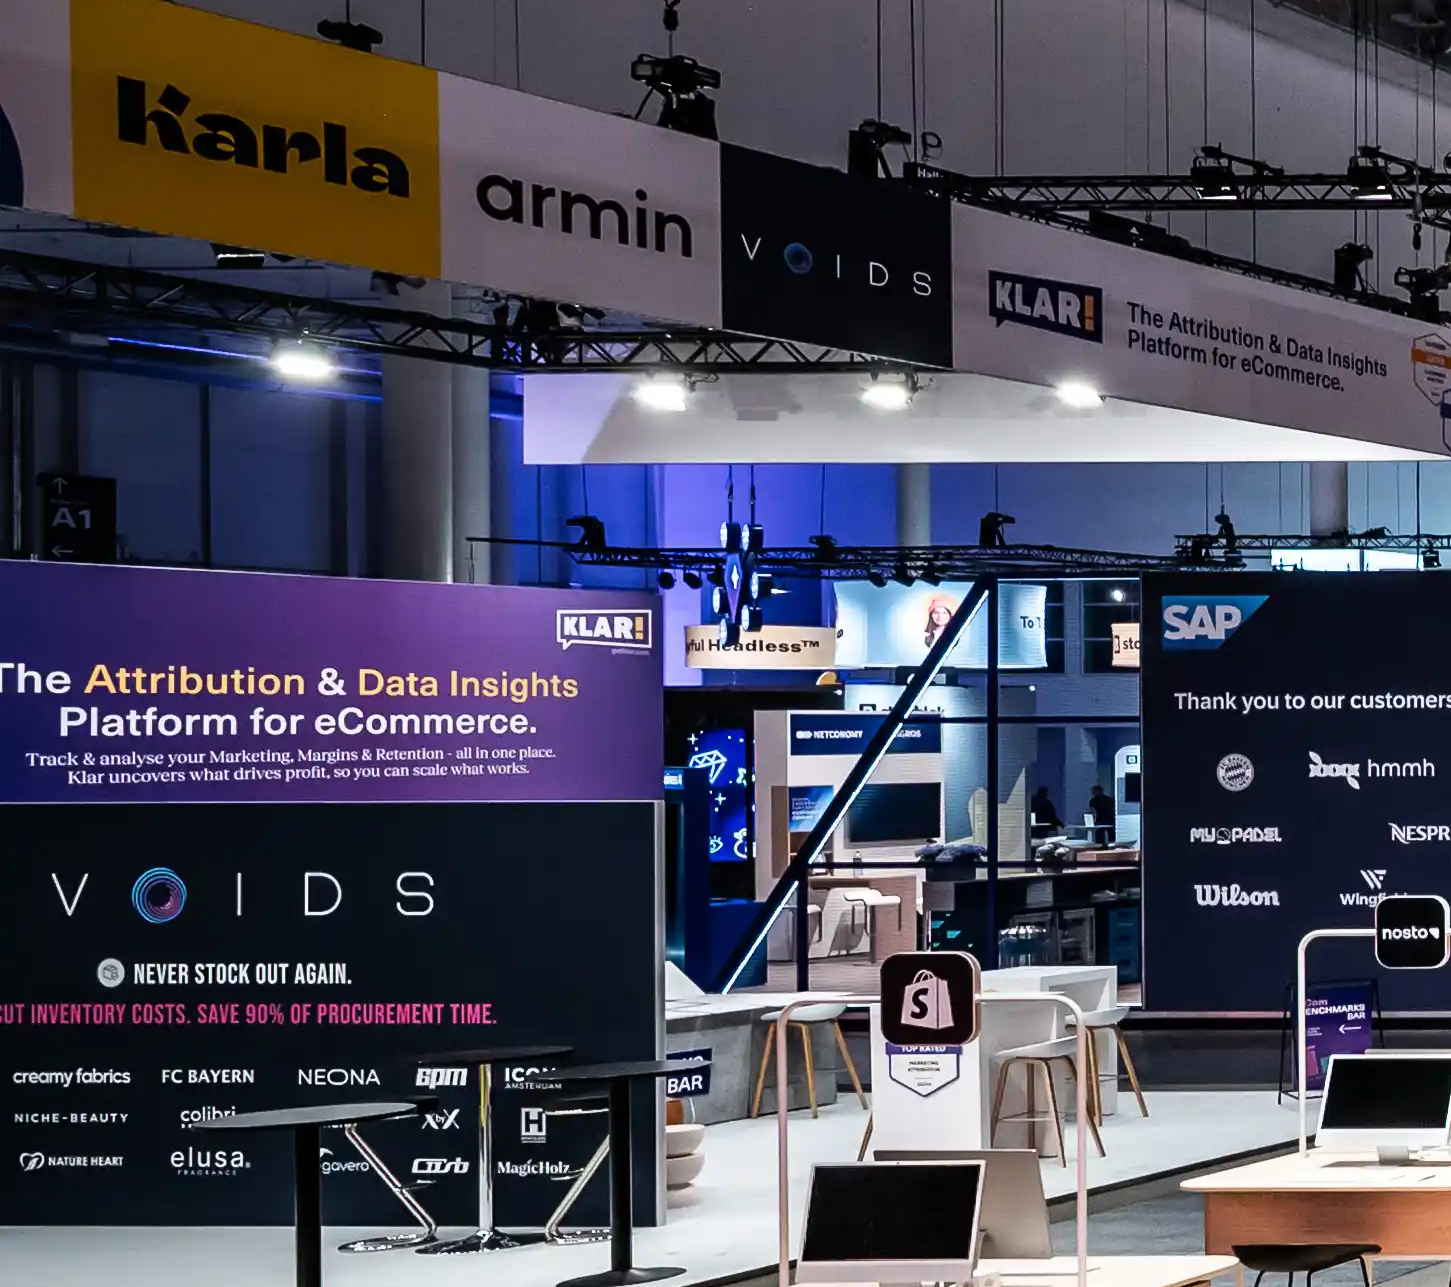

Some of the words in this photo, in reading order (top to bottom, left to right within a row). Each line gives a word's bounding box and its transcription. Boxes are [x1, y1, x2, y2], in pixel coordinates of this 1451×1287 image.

[116, 74, 410, 199] Karla
[477, 173, 694, 258] armin
[995, 279, 1094, 331] KLAR!
[1127, 301, 1164, 329] The
[1168, 311, 1265, 351] Attribution
[1268, 328, 1282, 352] &
[1286, 337, 1324, 363] Data
[1328, 346, 1388, 380] Insights
[1127, 333, 1208, 368] Platform
[1212, 343, 1236, 369] for
[1241, 352, 1345, 392] eCommerce.
[51, 507, 92, 529] A1
[563, 616, 644, 641] KLAR!
[1163, 605, 1242, 640] SAP
[84, 664, 305, 695] Attribution
[317, 667, 347, 696] &
[359, 668, 438, 697] Data
[450, 670, 579, 703] Insights
[1174, 692, 1237, 711] Thank
[1241, 695, 1279, 714] you
[1285, 694, 1306, 709] to
[1310, 695, 1345, 709] our
[60, 706, 237, 737] Platform
[250, 707, 304, 736] for
[314, 707, 537, 736] eCommerce.
[25, 751, 78, 766] Track
[82, 752, 96, 766] &
[100, 750, 164, 767] analyse
[168, 752, 206, 768] your
[209, 748, 294, 765] Marketing,
[298, 748, 358, 764] Margins
[362, 749, 373, 762] &
[376, 747, 444, 761] Retention
[455, 747, 473, 759] all
[476, 746, 488, 759] in
[491, 749, 517, 760] one
[519, 746, 556, 761] place.
[1368, 758, 1435, 778] hmmh
[68, 770, 104, 785] Klar
[109, 769, 186, 784] uncovers
[190, 767, 230, 782] what
[234, 766, 282, 781] drives
[285, 764, 331, 782] profit,
[333, 766, 351, 779] so
[353, 766, 381, 782] you
[384, 765, 409, 778] can
[412, 764, 447, 777] scale
[450, 763, 485, 776] what
[487, 763, 529, 776] works.
[1194, 884, 1281, 907] Wilson
[1382, 926, 1428, 941] nosto
[134, 963, 189, 985] NEVER
[194, 963, 250, 985] STOCK
[255, 963, 289, 985] OUT
[294, 963, 352, 985] AGAIN.
[31, 1003, 126, 1025] INVENTORY
[132, 1003, 191, 1025] COSTS.
[198, 1003, 240, 1025] SAVE
[246, 1003, 284, 1025] 90%
[290, 1003, 312, 1025] OF
[317, 1003, 445, 1025] PROCUREMENT
[450, 1003, 497, 1025] TIME.
[1305, 1004, 1366, 1015] ENCHMARKS
[1347, 1012, 1366, 1021] BAR
[13, 1070, 74, 1088] creamy
[76, 1068, 131, 1084] fabrics
[161, 1069, 183, 1084] FC
[188, 1069, 254, 1084] BAYERN
[298, 1069, 381, 1086] NEONA
[505, 1082, 562, 1090] AMSTERDAM
[667, 1075, 703, 1094] BAR
[14, 1113, 129, 1124] NICHE-BEAUTY
[48, 1156, 88, 1167] NATURE
[90, 1156, 124, 1167] HEART
[497, 1158, 570, 1178] MagicHolz
